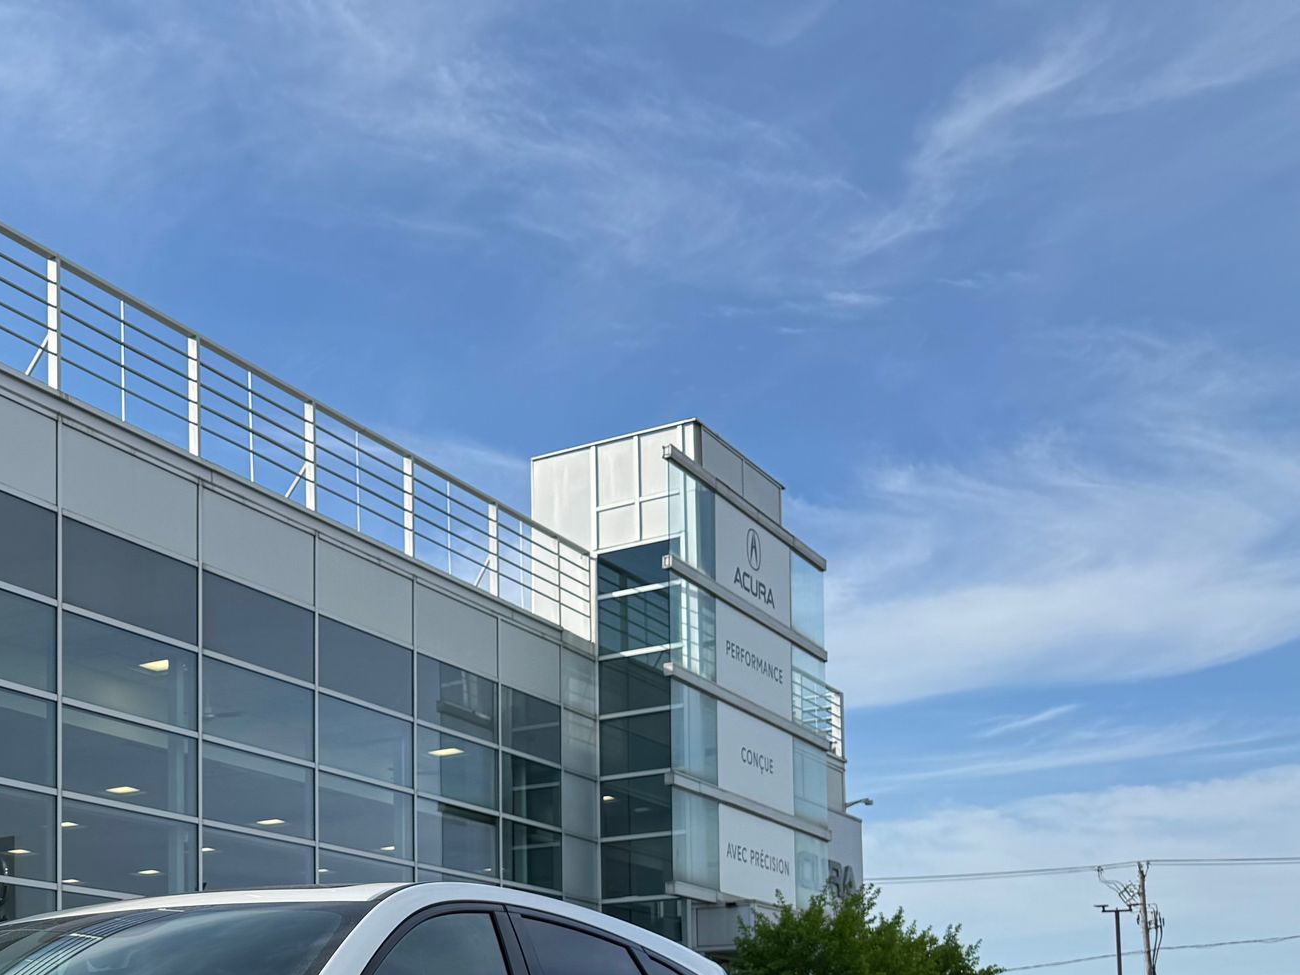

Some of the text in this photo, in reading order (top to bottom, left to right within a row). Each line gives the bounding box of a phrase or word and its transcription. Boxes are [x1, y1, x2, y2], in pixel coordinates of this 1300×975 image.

[733, 566, 776, 609] ACURA
[725, 640, 784, 685] PERFORMANCE
[740, 746, 774, 775] CONÇUE
[726, 842, 790, 876] AVEC PRÉCISION
